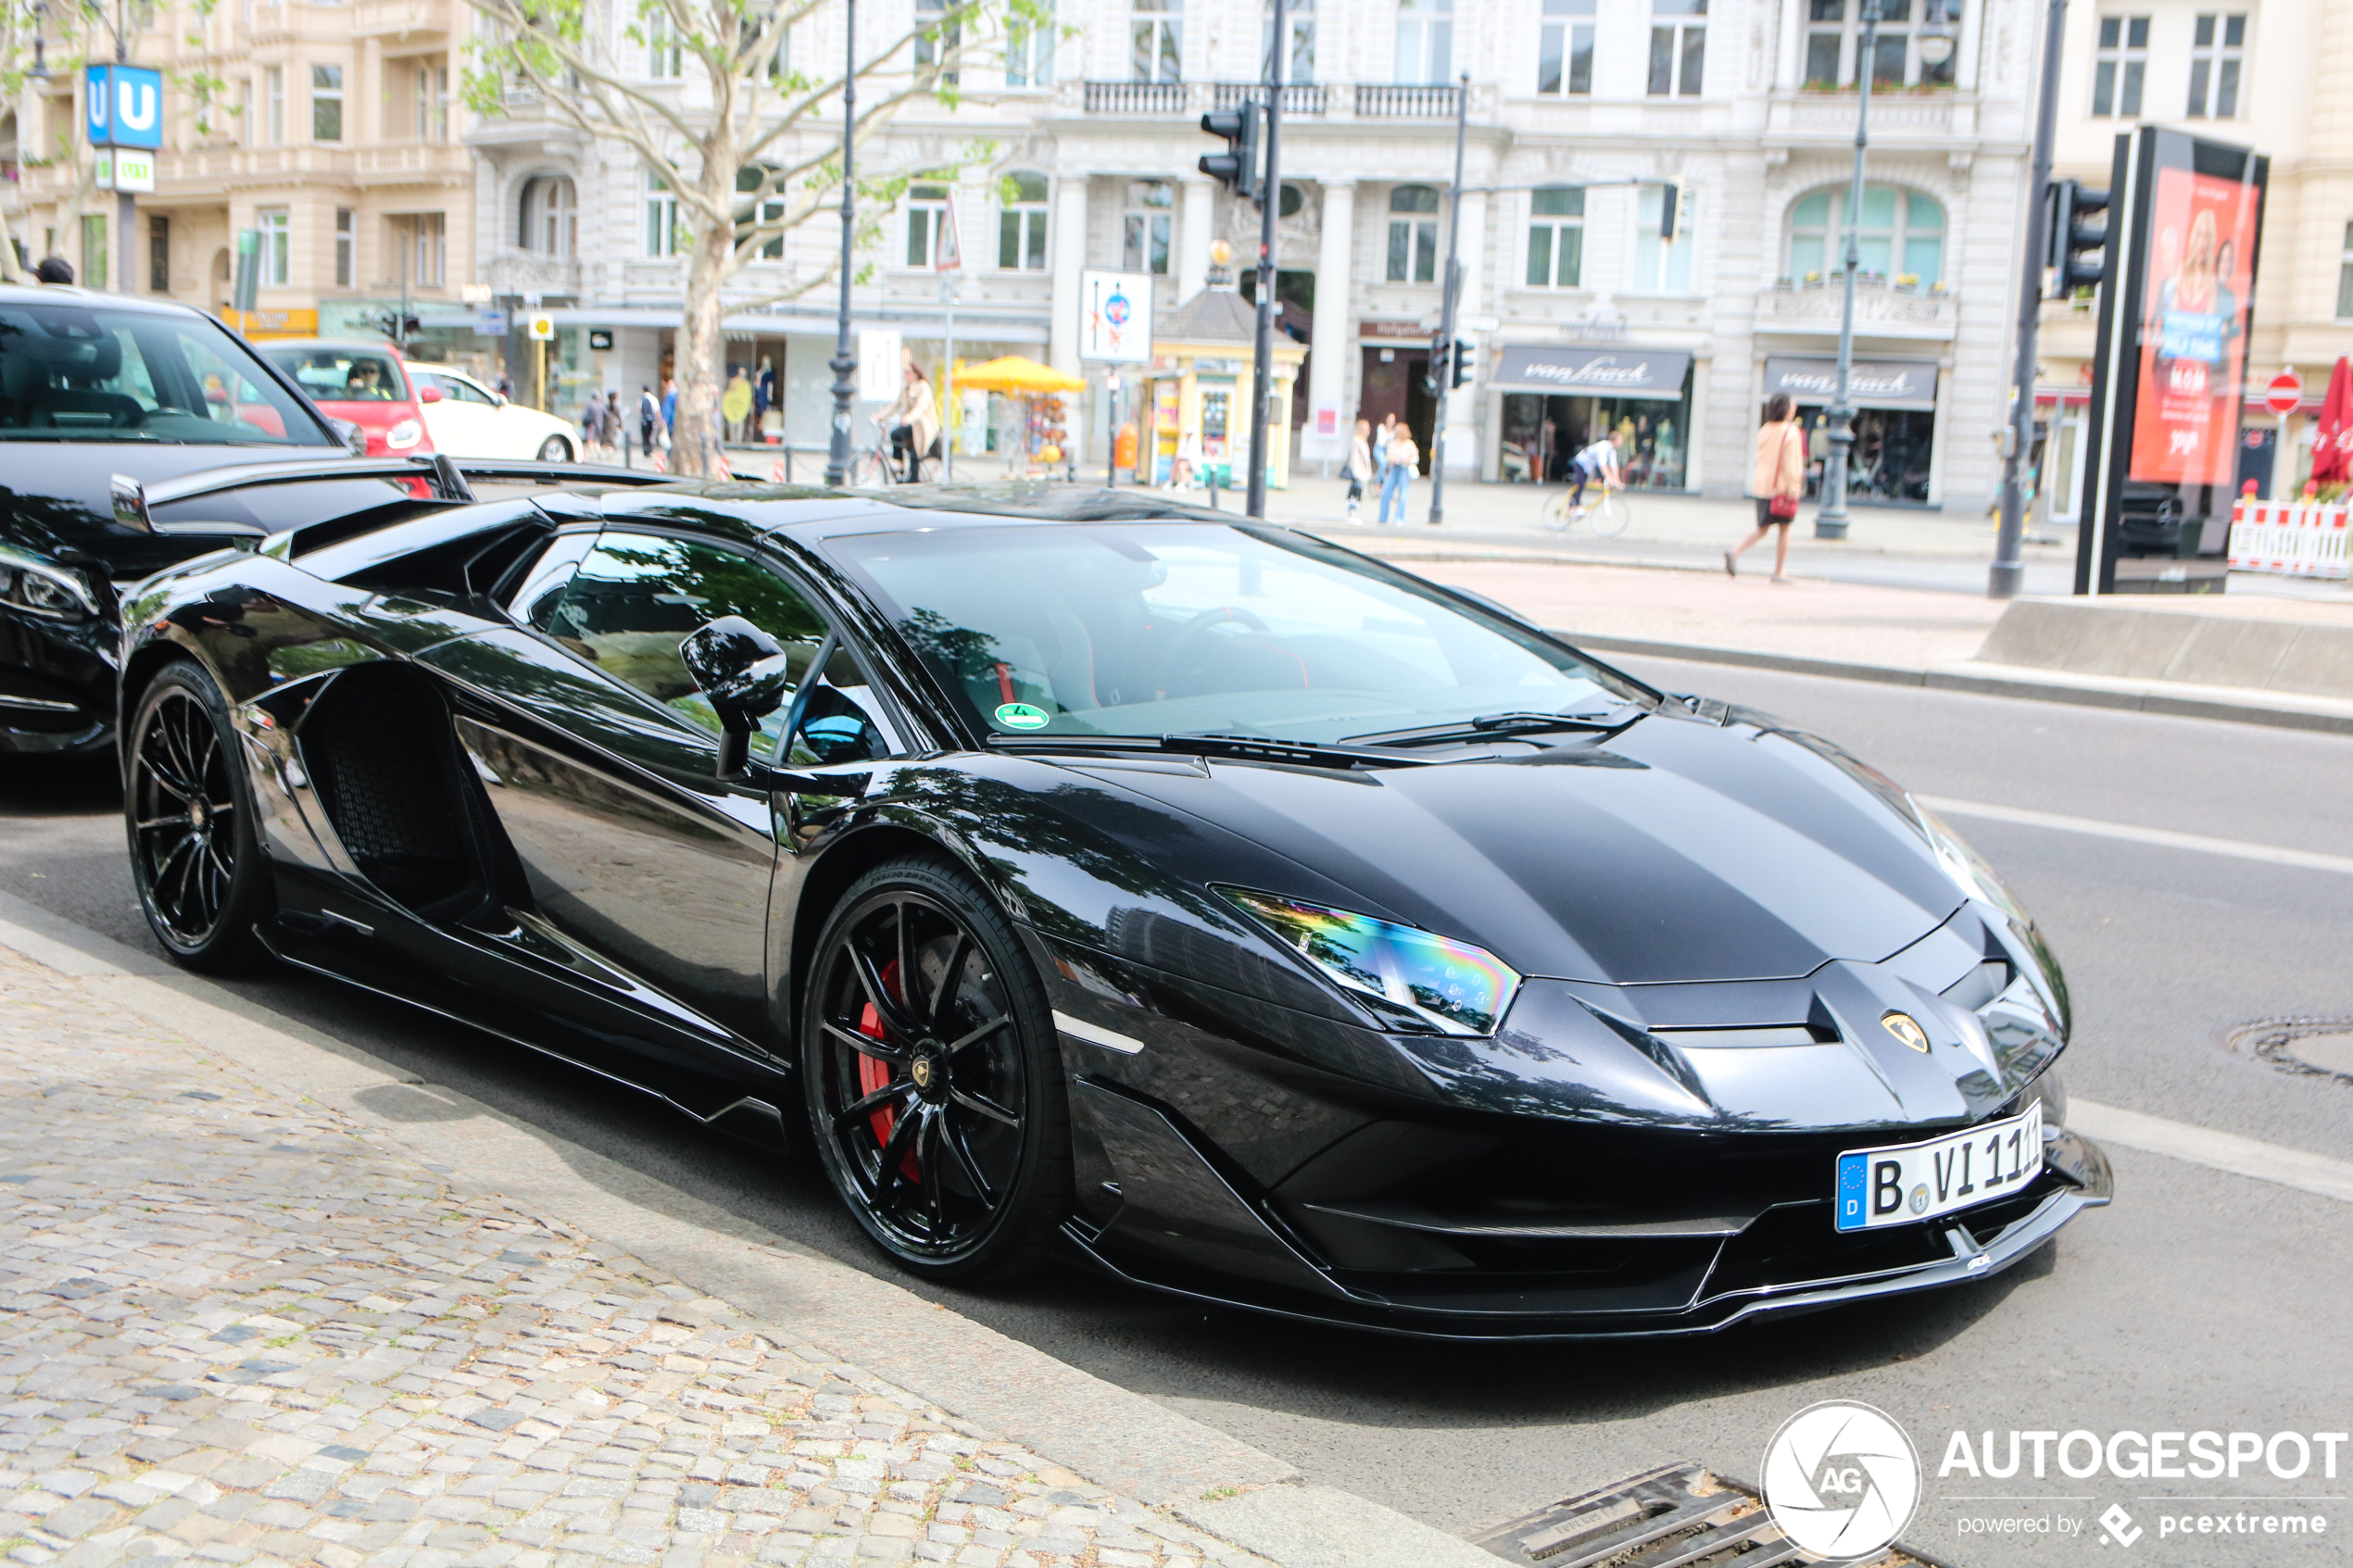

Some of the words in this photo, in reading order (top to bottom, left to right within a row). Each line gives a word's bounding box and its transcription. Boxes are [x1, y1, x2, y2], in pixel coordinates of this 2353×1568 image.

[89, 80, 107, 128] U
[119, 80, 155, 131] U
[1014, 706, 1028, 716] 4
[871, 872, 903, 886] 255/30
[904, 872, 933, 884] ZR20
[1873, 1160, 1903, 1216] B
[1934, 1141, 1974, 1203] VI
[1984, 1112, 2041, 1189] 1111
[1846, 1199, 1858, 1216] D
